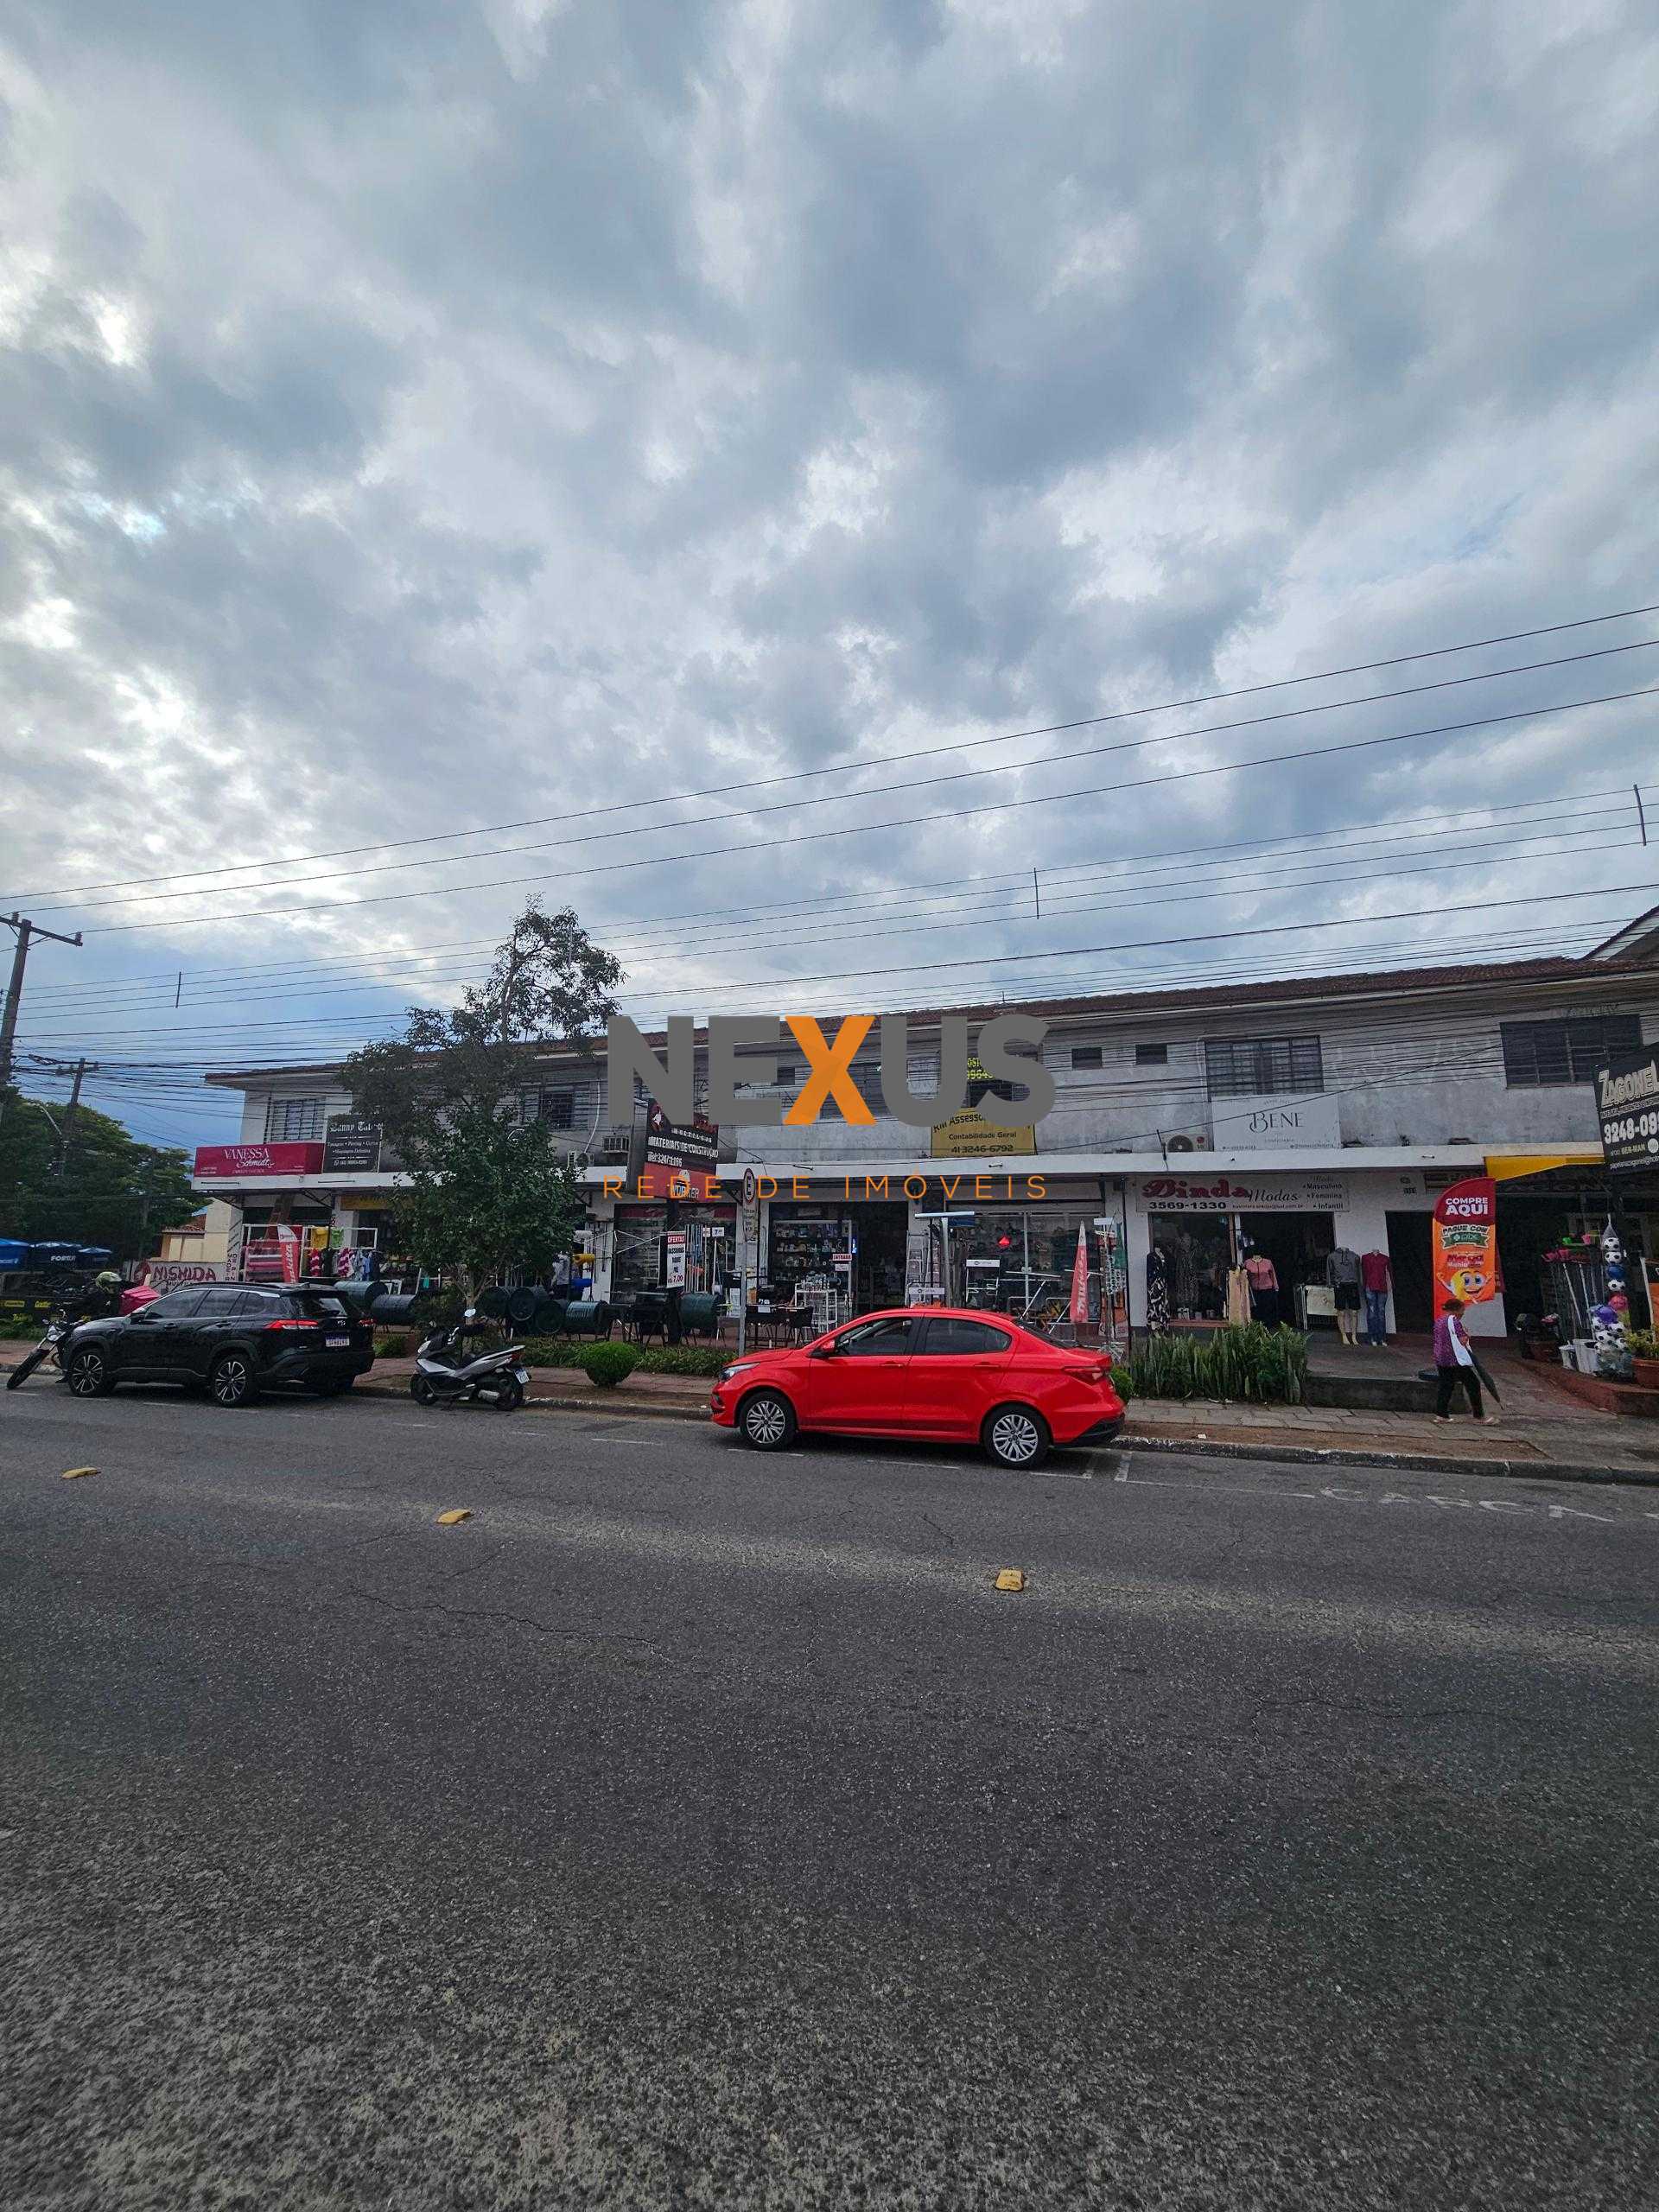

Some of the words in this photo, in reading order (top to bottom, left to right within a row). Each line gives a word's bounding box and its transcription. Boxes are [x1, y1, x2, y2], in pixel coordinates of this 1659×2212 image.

[1599, 1059, 1659, 1108] ZAGONEL
[1249, 1112, 1305, 1134] BENE
[1604, 1111, 1659, 1145] 3248-08
[224, 1147, 270, 1160] VANESSA
[1141, 1178, 1250, 1199] Dinda
[1247, 1188, 1299, 1202] Modas
[1446, 1205, 1488, 1217] AQUI
